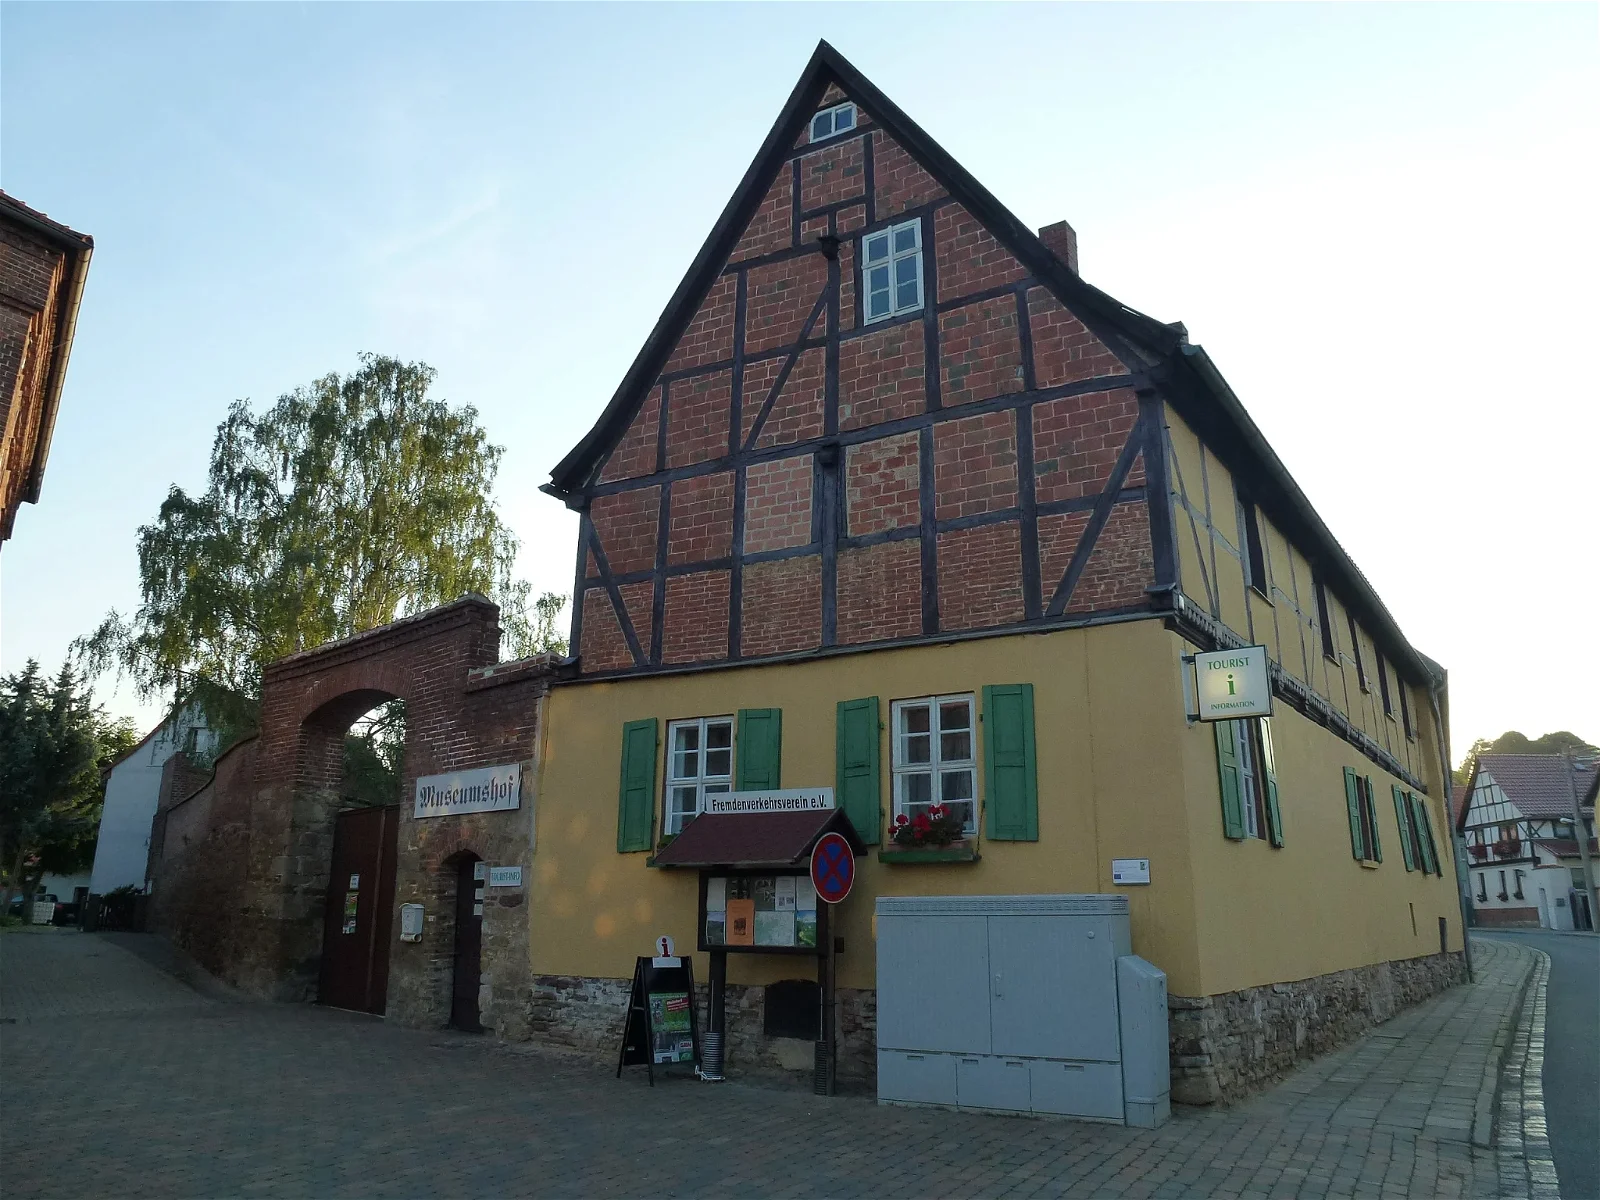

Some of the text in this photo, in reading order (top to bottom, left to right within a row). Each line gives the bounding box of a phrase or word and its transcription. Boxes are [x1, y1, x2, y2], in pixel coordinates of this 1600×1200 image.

[1207, 657, 1250, 670] TOURIST
[1226, 674, 1236, 695] i
[1211, 700, 1255, 710] INFORMATION
[420, 775, 513, 808] Museumshof
[712, 794, 827, 811] Fremdenverkehrsverein e.V.
[491, 871, 520, 881] TOURIST-INFO
[661, 937, 670, 957] i
